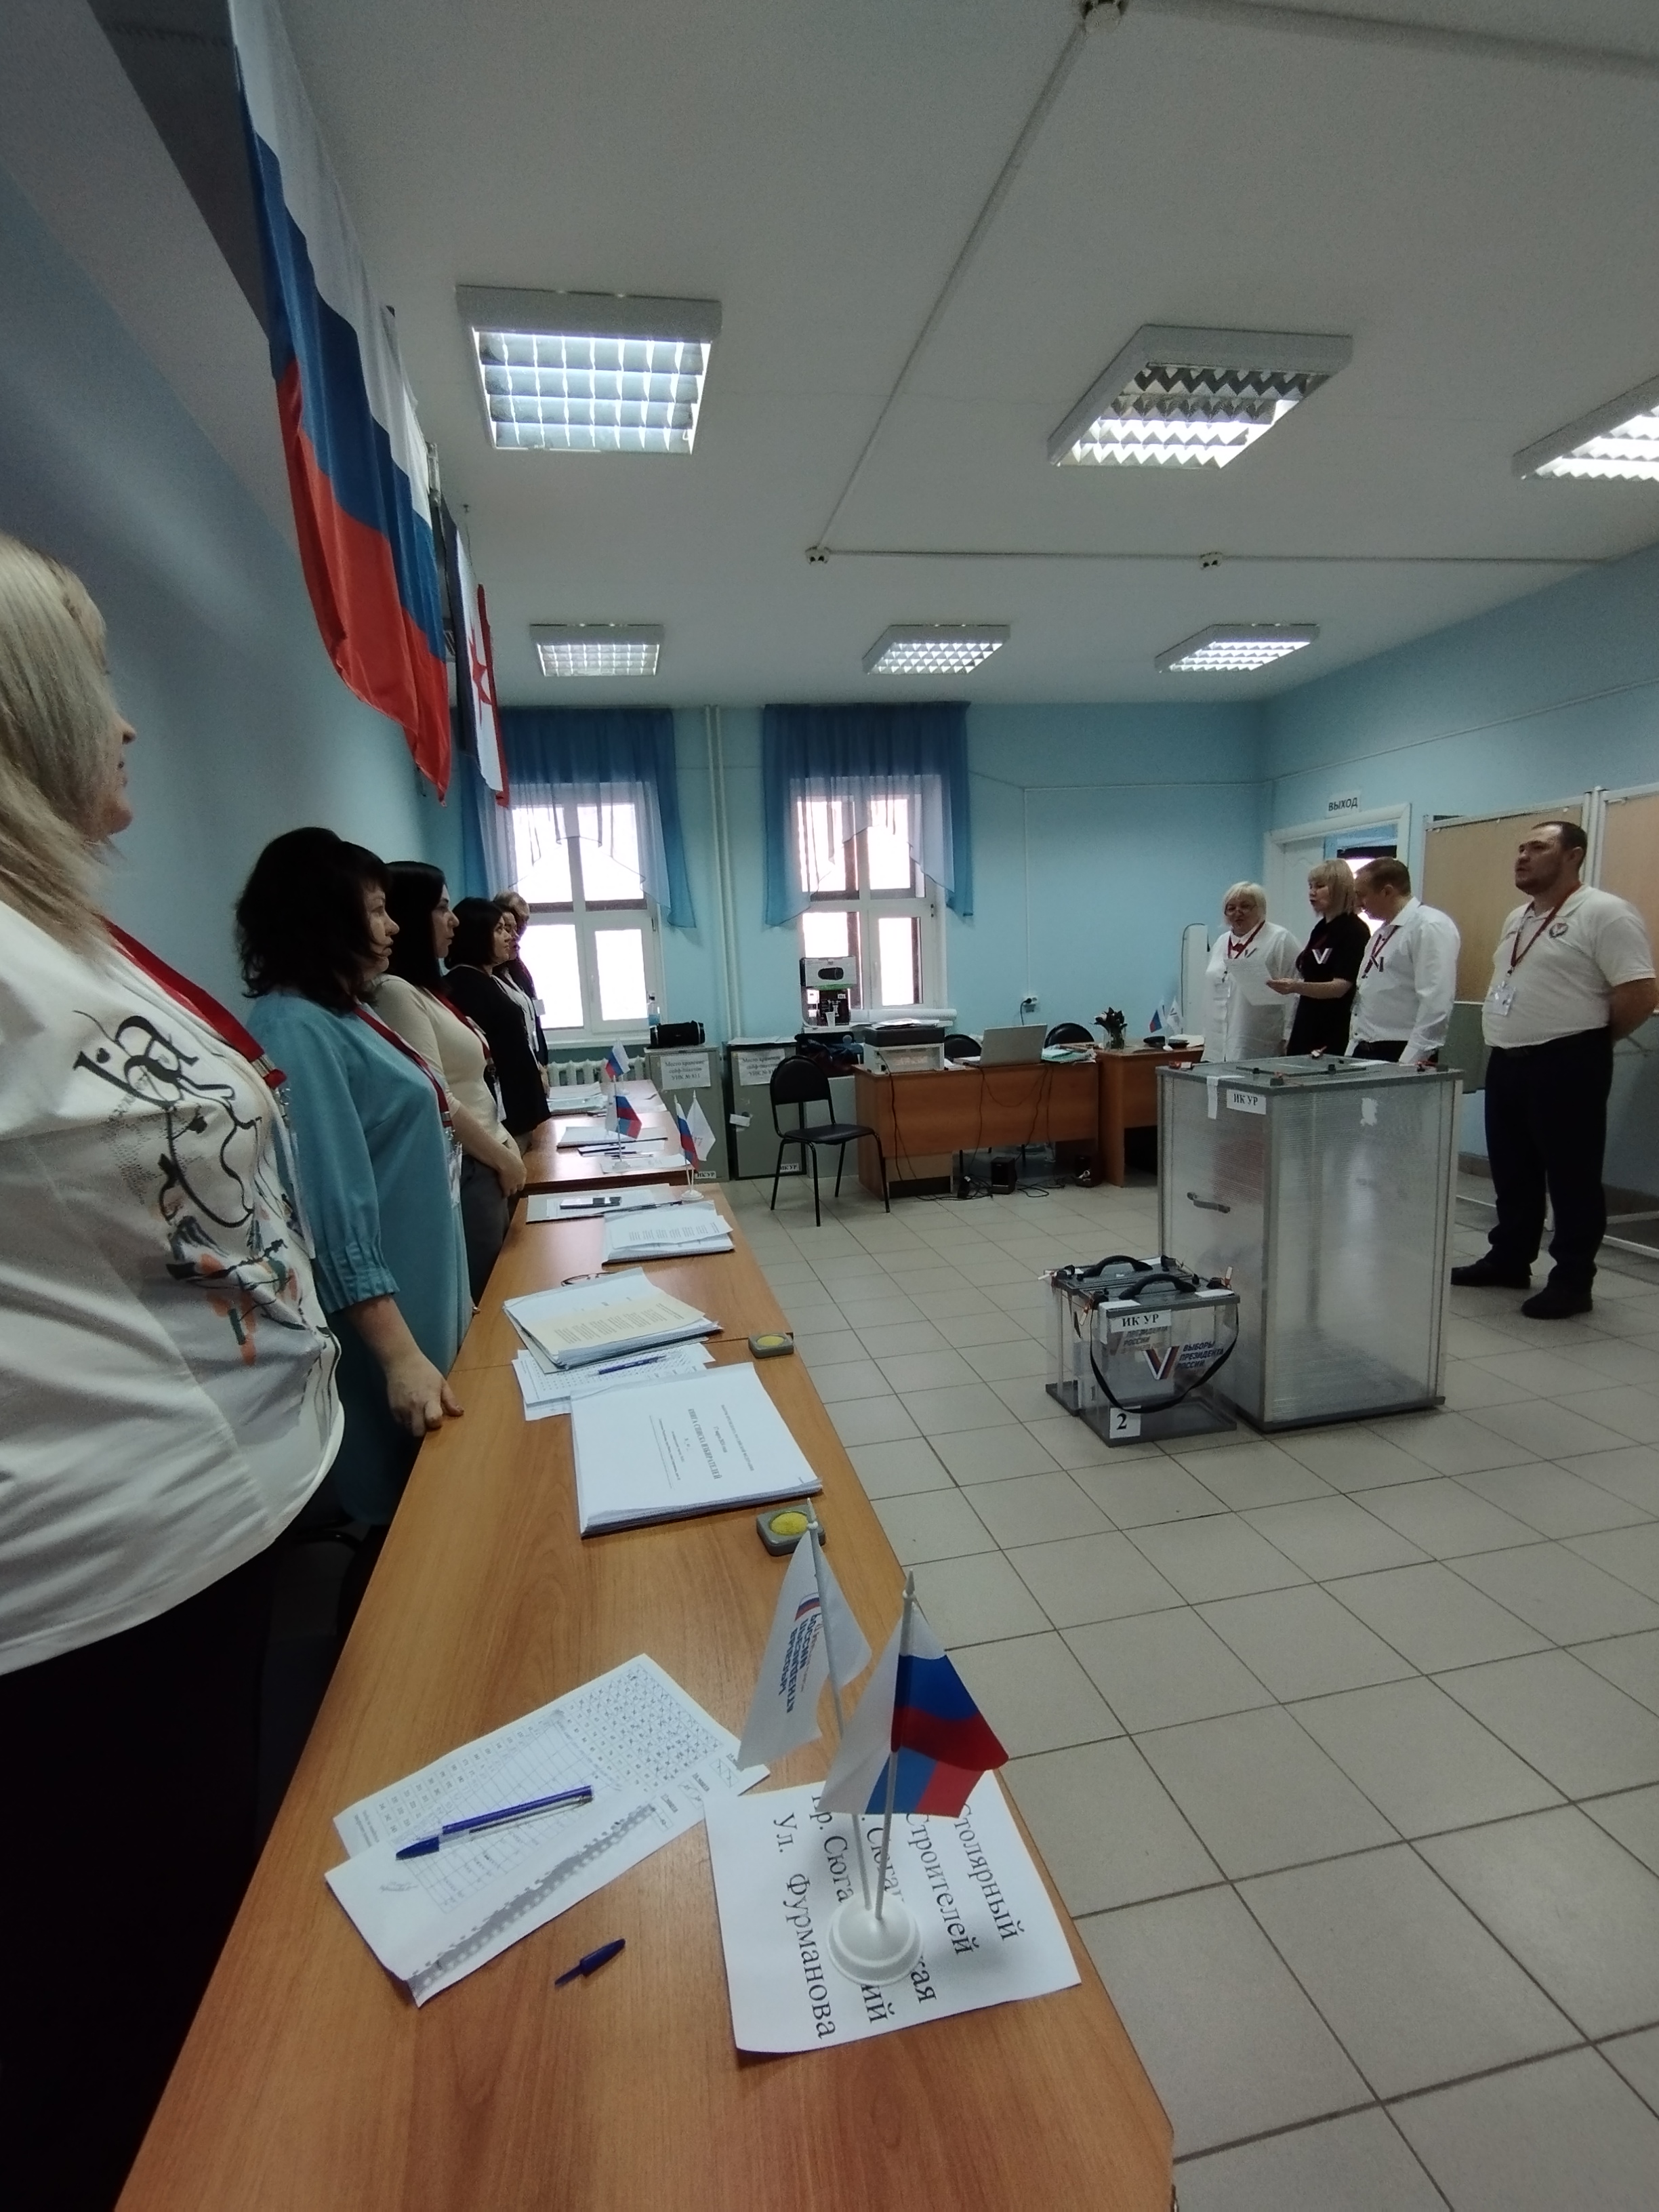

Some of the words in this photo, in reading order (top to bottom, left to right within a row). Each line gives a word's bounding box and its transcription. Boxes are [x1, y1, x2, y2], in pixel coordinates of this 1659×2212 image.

[1328, 797, 1357, 811] ВЫХОД
[1233, 1093, 1245, 1104] ИК
[1248, 1095, 1258, 1105] УР
[1122, 1316, 1140, 1327] ИК
[1144, 1313, 1160, 1324] УР
[1183, 1341, 1216, 1352] ВЫБОРЫ
[1179, 1348, 1224, 1361] ПРЕЗИДЕНТА
[1176, 1360, 1205, 1370] РОССИИ
[1116, 1413, 1127, 1430] 2
[701, 1443, 722, 1479] ИЗБИРАТЕЛЕЙ
[773, 1812, 798, 1853] Ул.
[905, 1814, 979, 1954] Строителей
[782, 1873, 836, 2040] Фурманова
